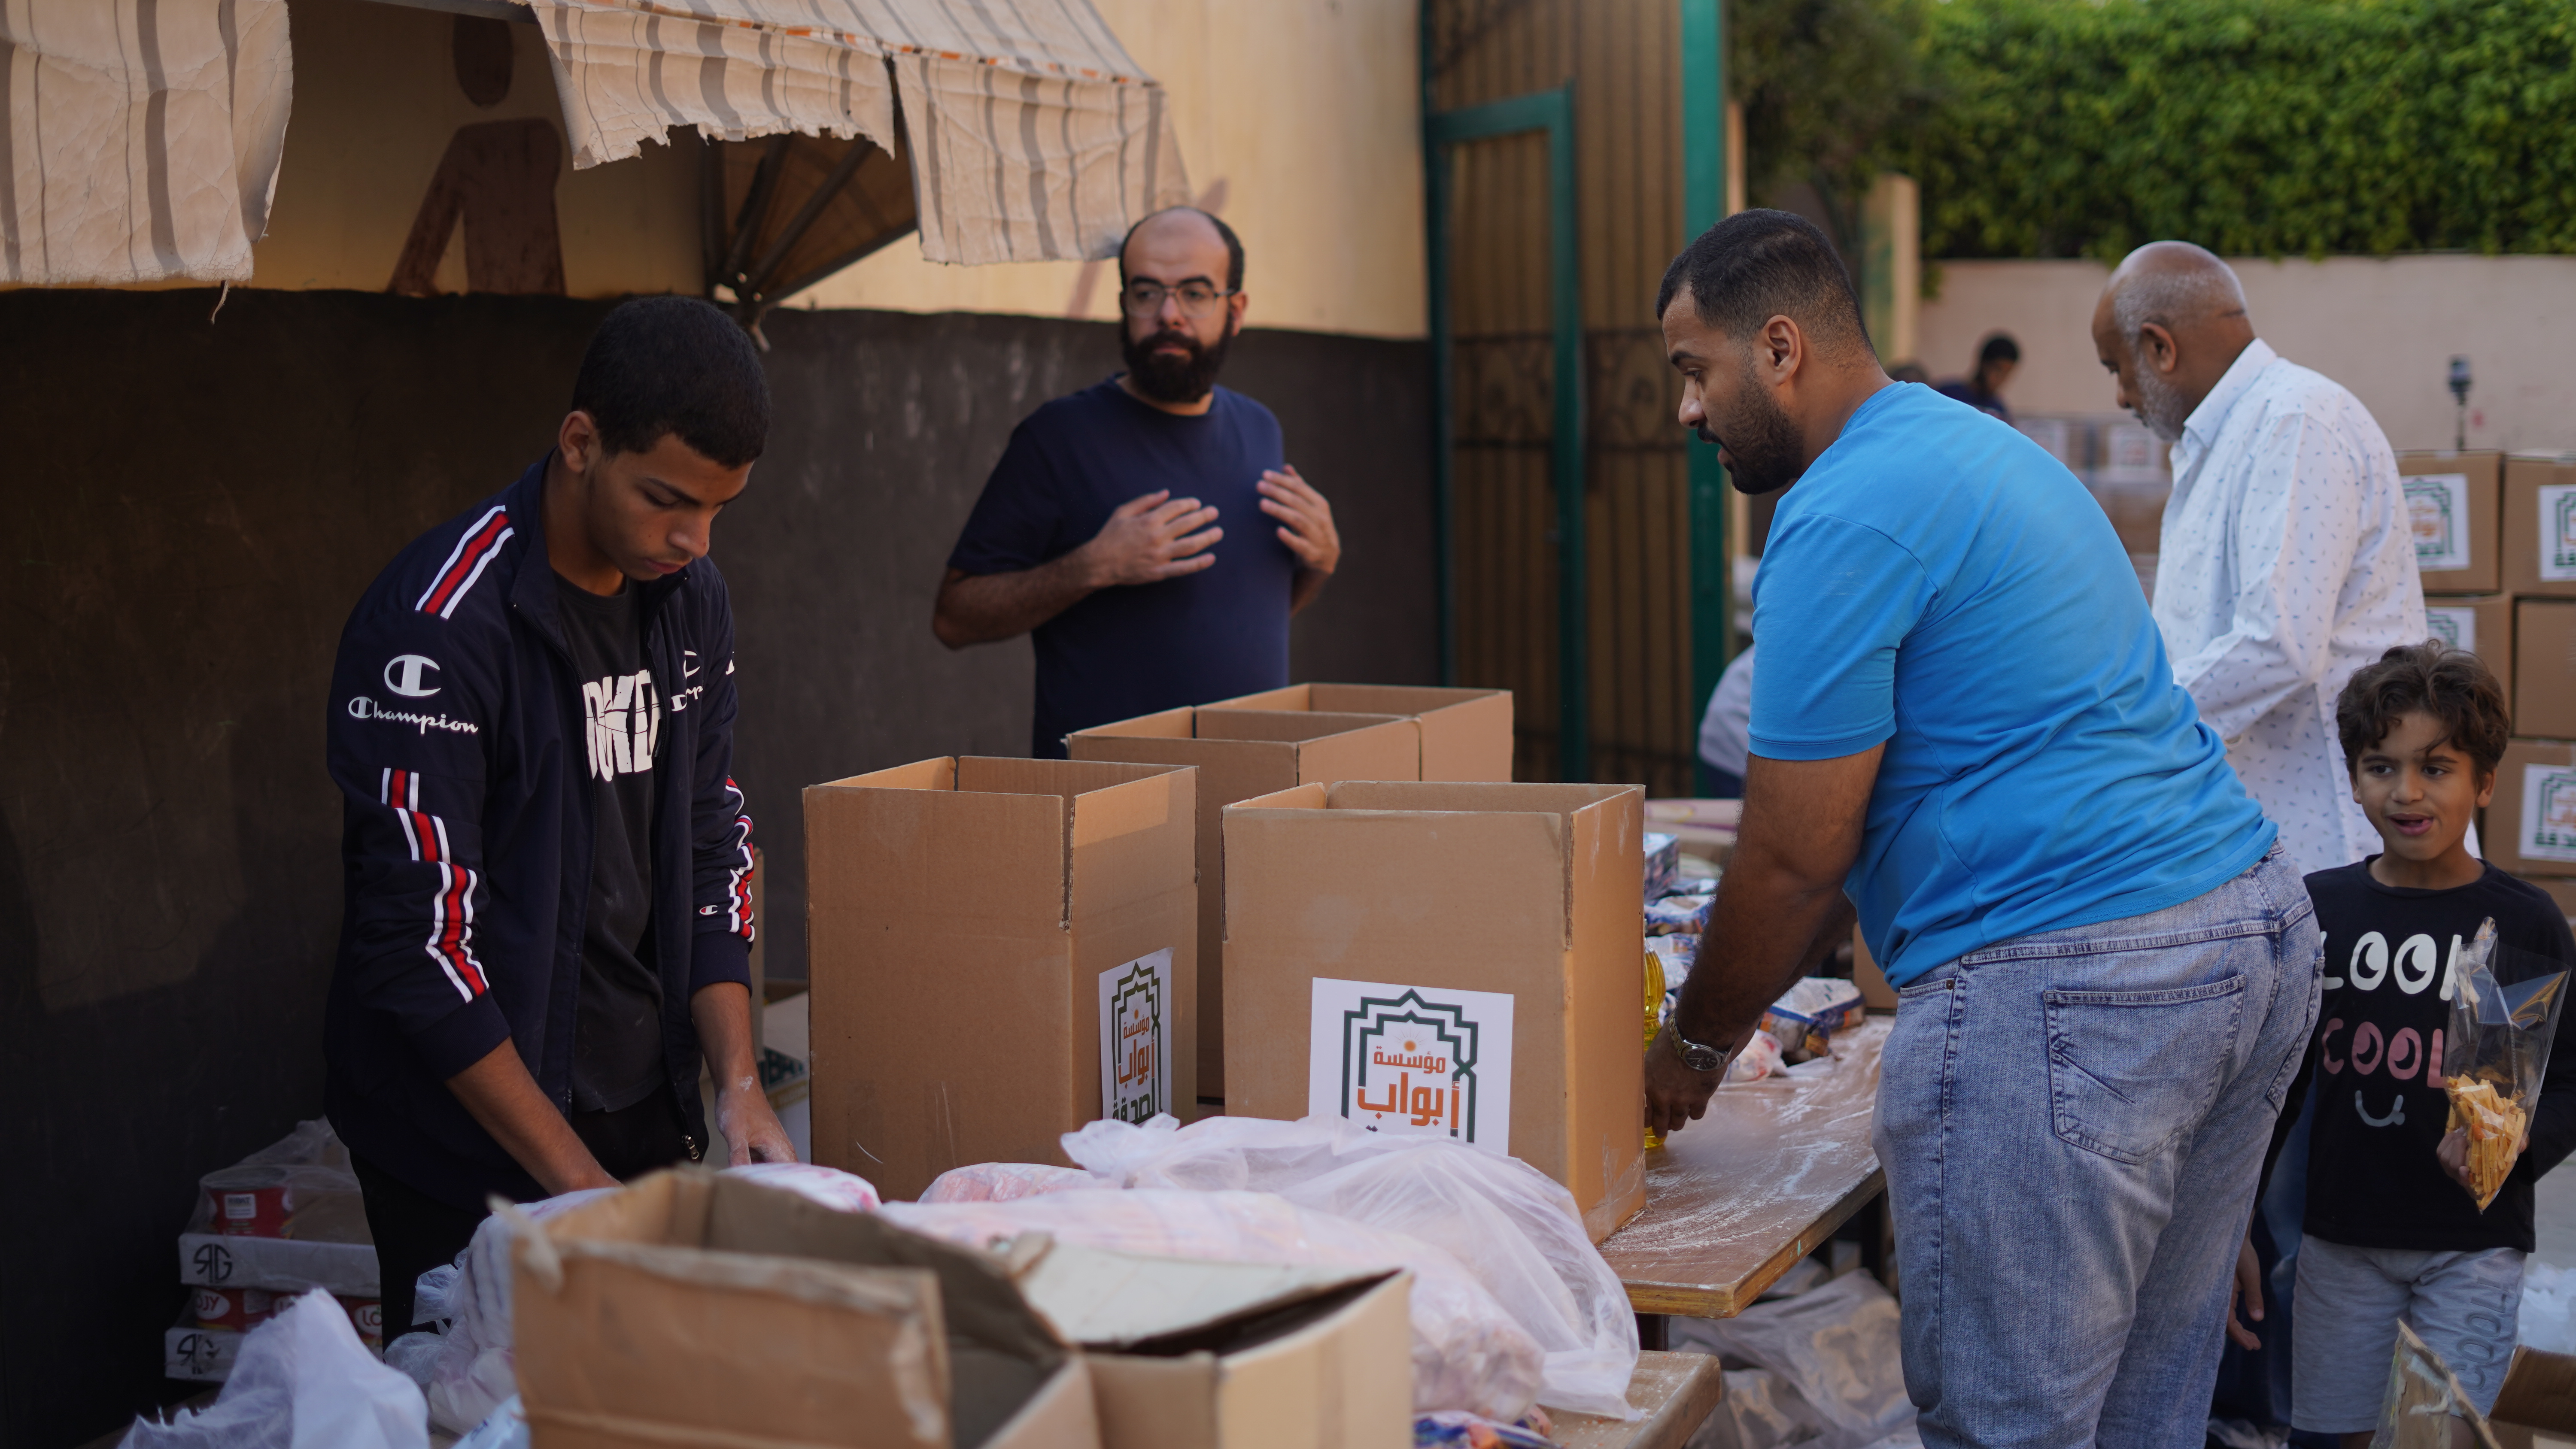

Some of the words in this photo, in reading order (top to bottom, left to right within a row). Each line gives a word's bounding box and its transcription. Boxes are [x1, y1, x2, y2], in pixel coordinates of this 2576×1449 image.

[348, 696, 479, 734] Champion
[1123, 1014, 1150, 1040] مؤسسة
[1118, 1034, 1155, 1089] أبواب
[1373, 1045, 1446, 1074] مؤسسة
[2321, 1017, 2451, 1088] COOL
[1357, 1071, 1460, 1127] أبواب
